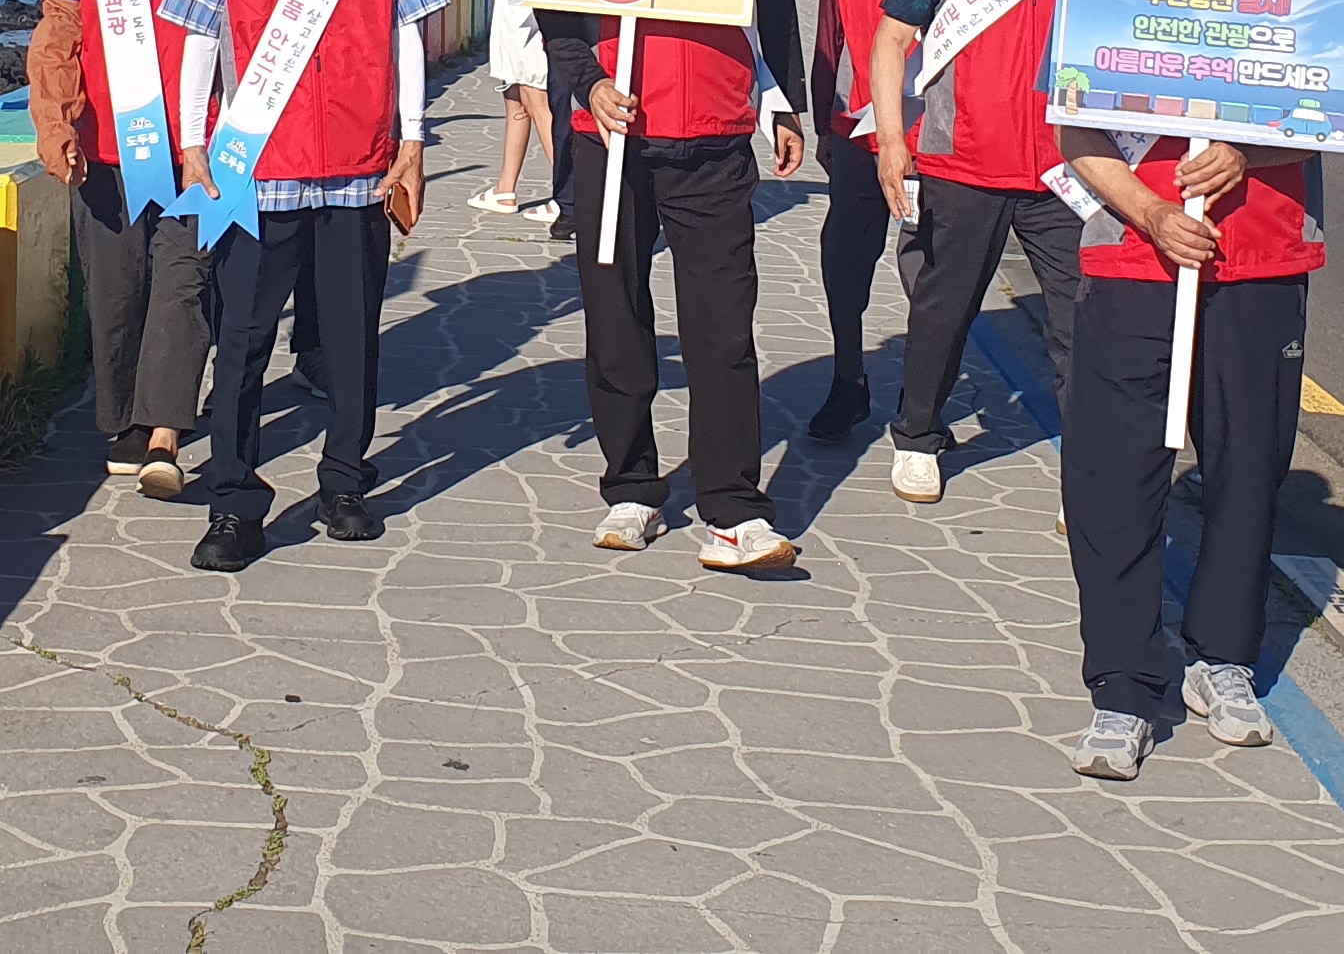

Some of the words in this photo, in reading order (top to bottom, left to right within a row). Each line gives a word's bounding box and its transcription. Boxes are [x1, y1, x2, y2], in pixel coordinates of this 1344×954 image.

[132, 15, 147, 45] 도두
[932, 2, 960, 39] 관광
[1133, 14, 1203, 46] 안전한
[1204, 20, 1296, 53] 관광으로
[248, 26, 289, 96] 안쓰기
[933, 37, 953, 61] 도두
[1094, 45, 1185, 78] 아름다운
[1187, 53, 1235, 83] 추억
[1237, 59, 1330, 92] 만드세요
[266, 80, 284, 111] 도두
